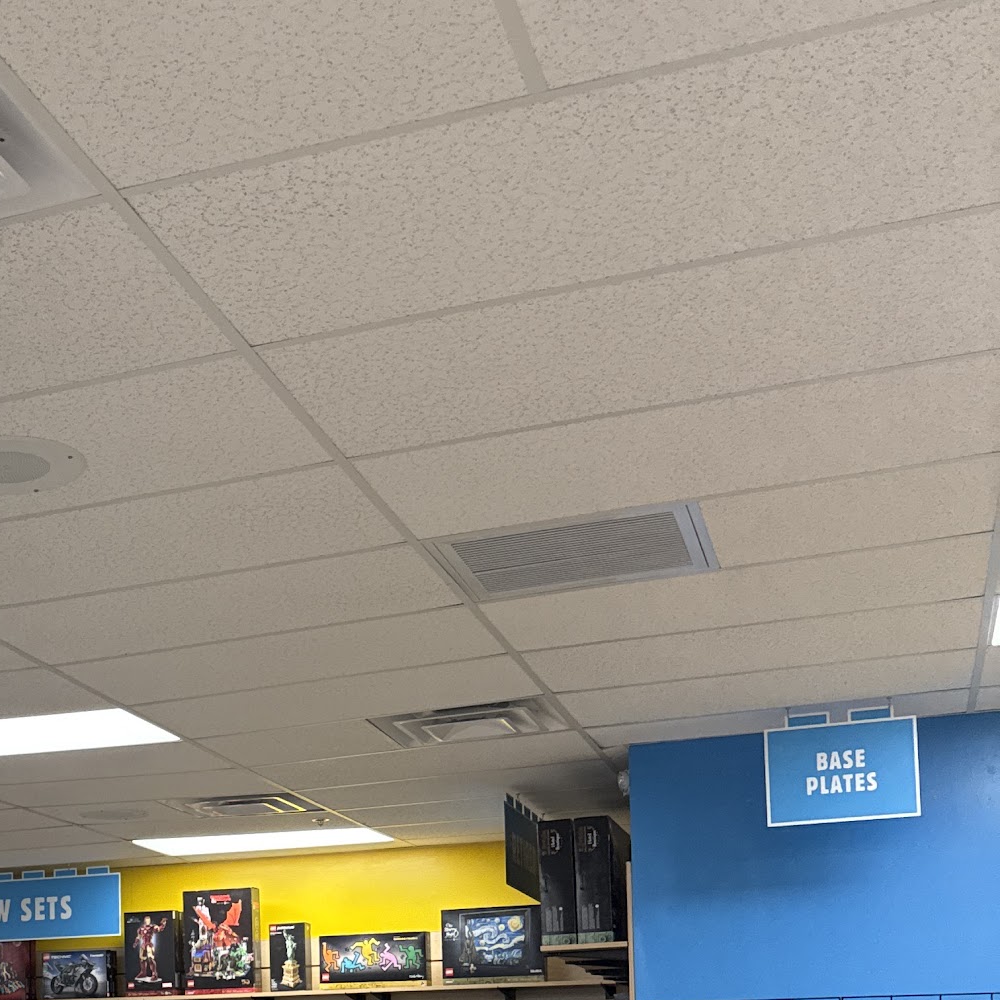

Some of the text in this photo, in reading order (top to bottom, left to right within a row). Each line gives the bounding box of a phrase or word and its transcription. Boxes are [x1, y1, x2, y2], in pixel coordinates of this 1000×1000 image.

[816, 748, 866, 771] BASE
[806, 771, 878, 796] PLATES
[20, 895, 73, 922] SETS
